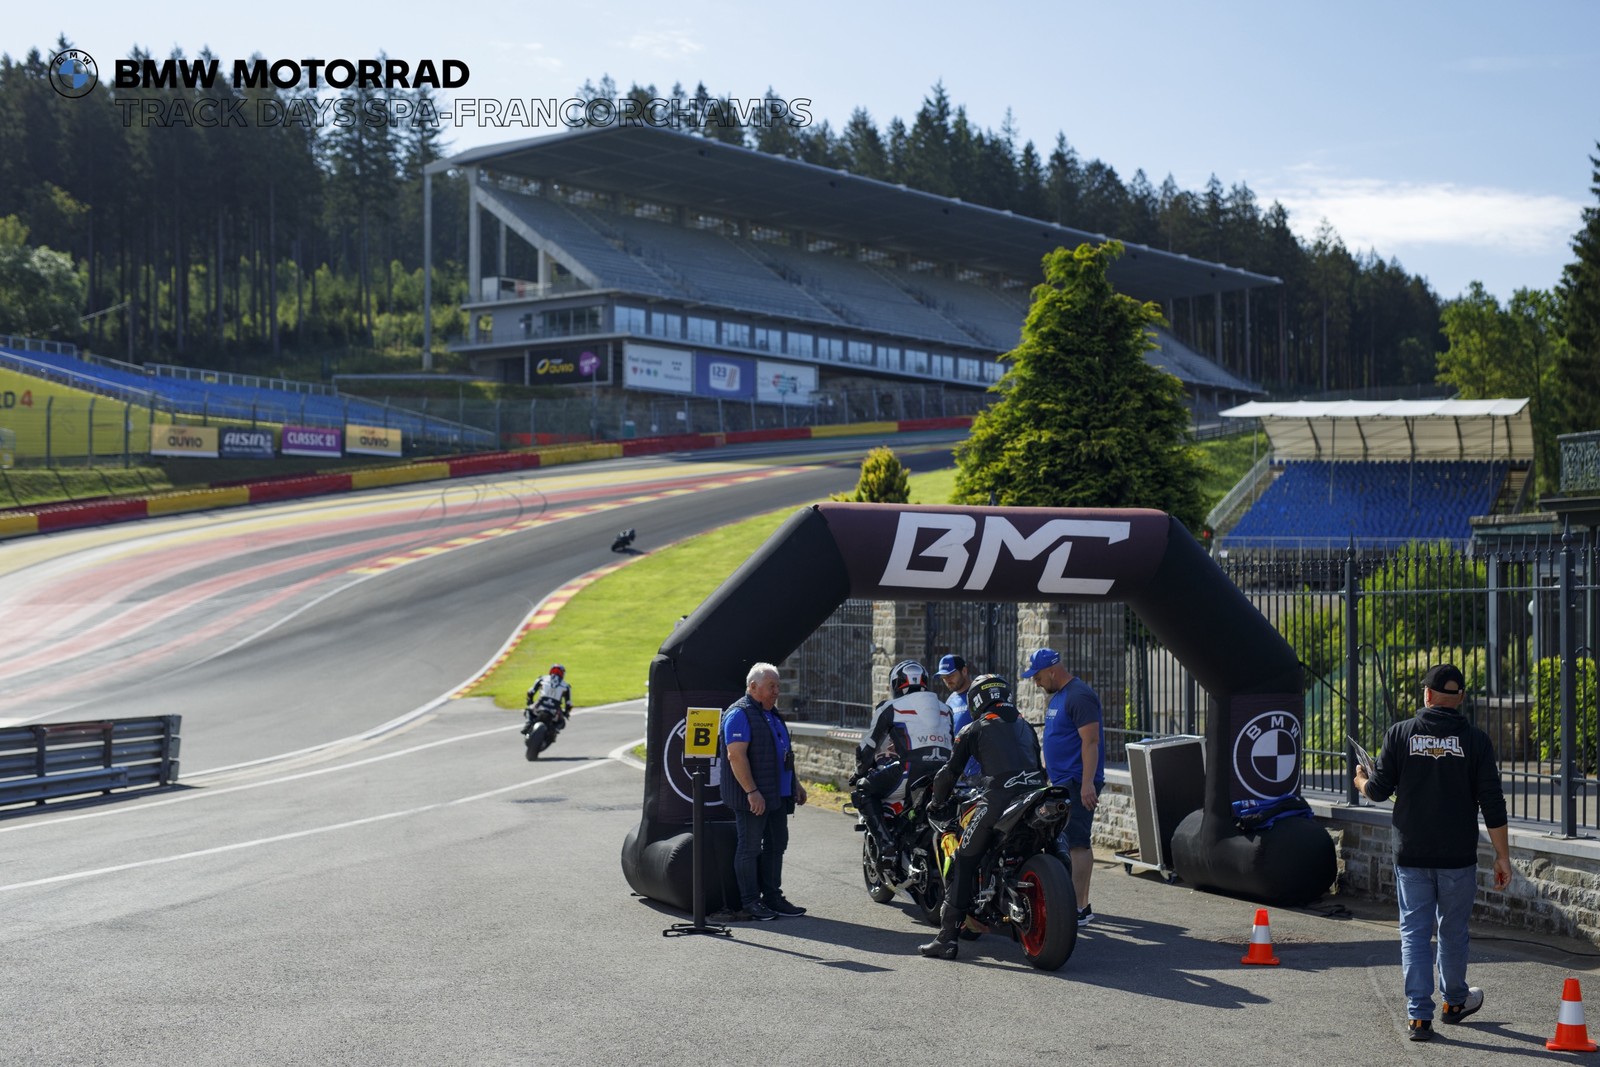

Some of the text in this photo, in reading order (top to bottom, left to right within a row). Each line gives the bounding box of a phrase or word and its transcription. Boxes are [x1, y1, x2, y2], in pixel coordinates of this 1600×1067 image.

[712, 366, 727, 378] 123
[20, 390, 33, 407] 4
[168, 436, 203, 448] auvio
[224, 432, 266, 446] AISIN
[325, 434, 336, 447] 21
[360, 436, 389, 448] auvio
[878, 511, 1131, 595] BMC
[973, 693, 984, 708] 21
[1245, 715, 1300, 741] BMW
[694, 728, 710, 746] B
[1412, 737, 1460, 753] MICHAEL
